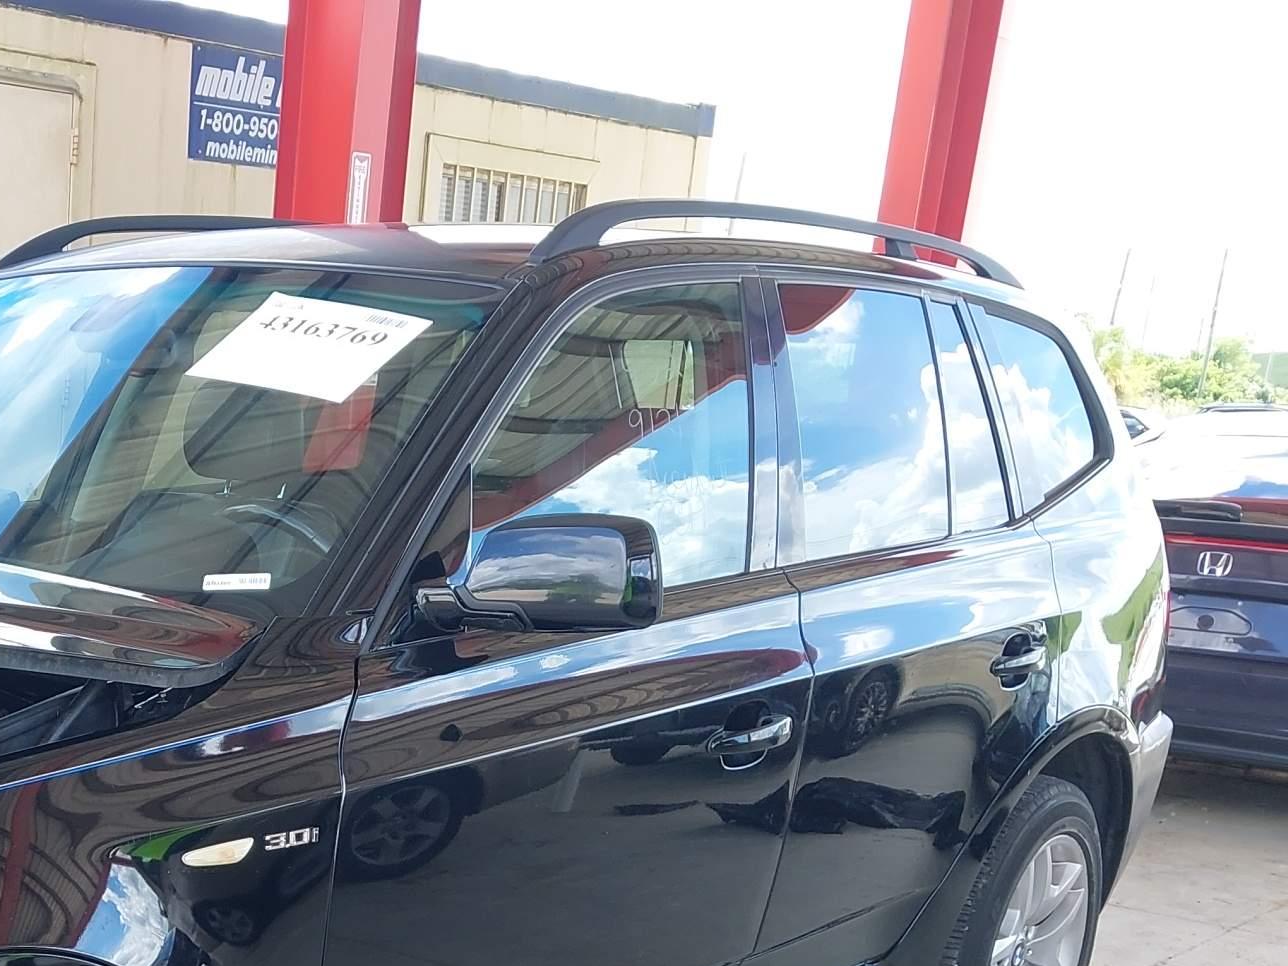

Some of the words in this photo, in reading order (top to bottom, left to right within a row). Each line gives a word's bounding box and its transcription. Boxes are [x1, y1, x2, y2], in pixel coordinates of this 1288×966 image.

[195, 56, 276, 106] mobile
[200, 108, 280, 140] 1-800-950
[259, 315, 389, 346] 43163769
